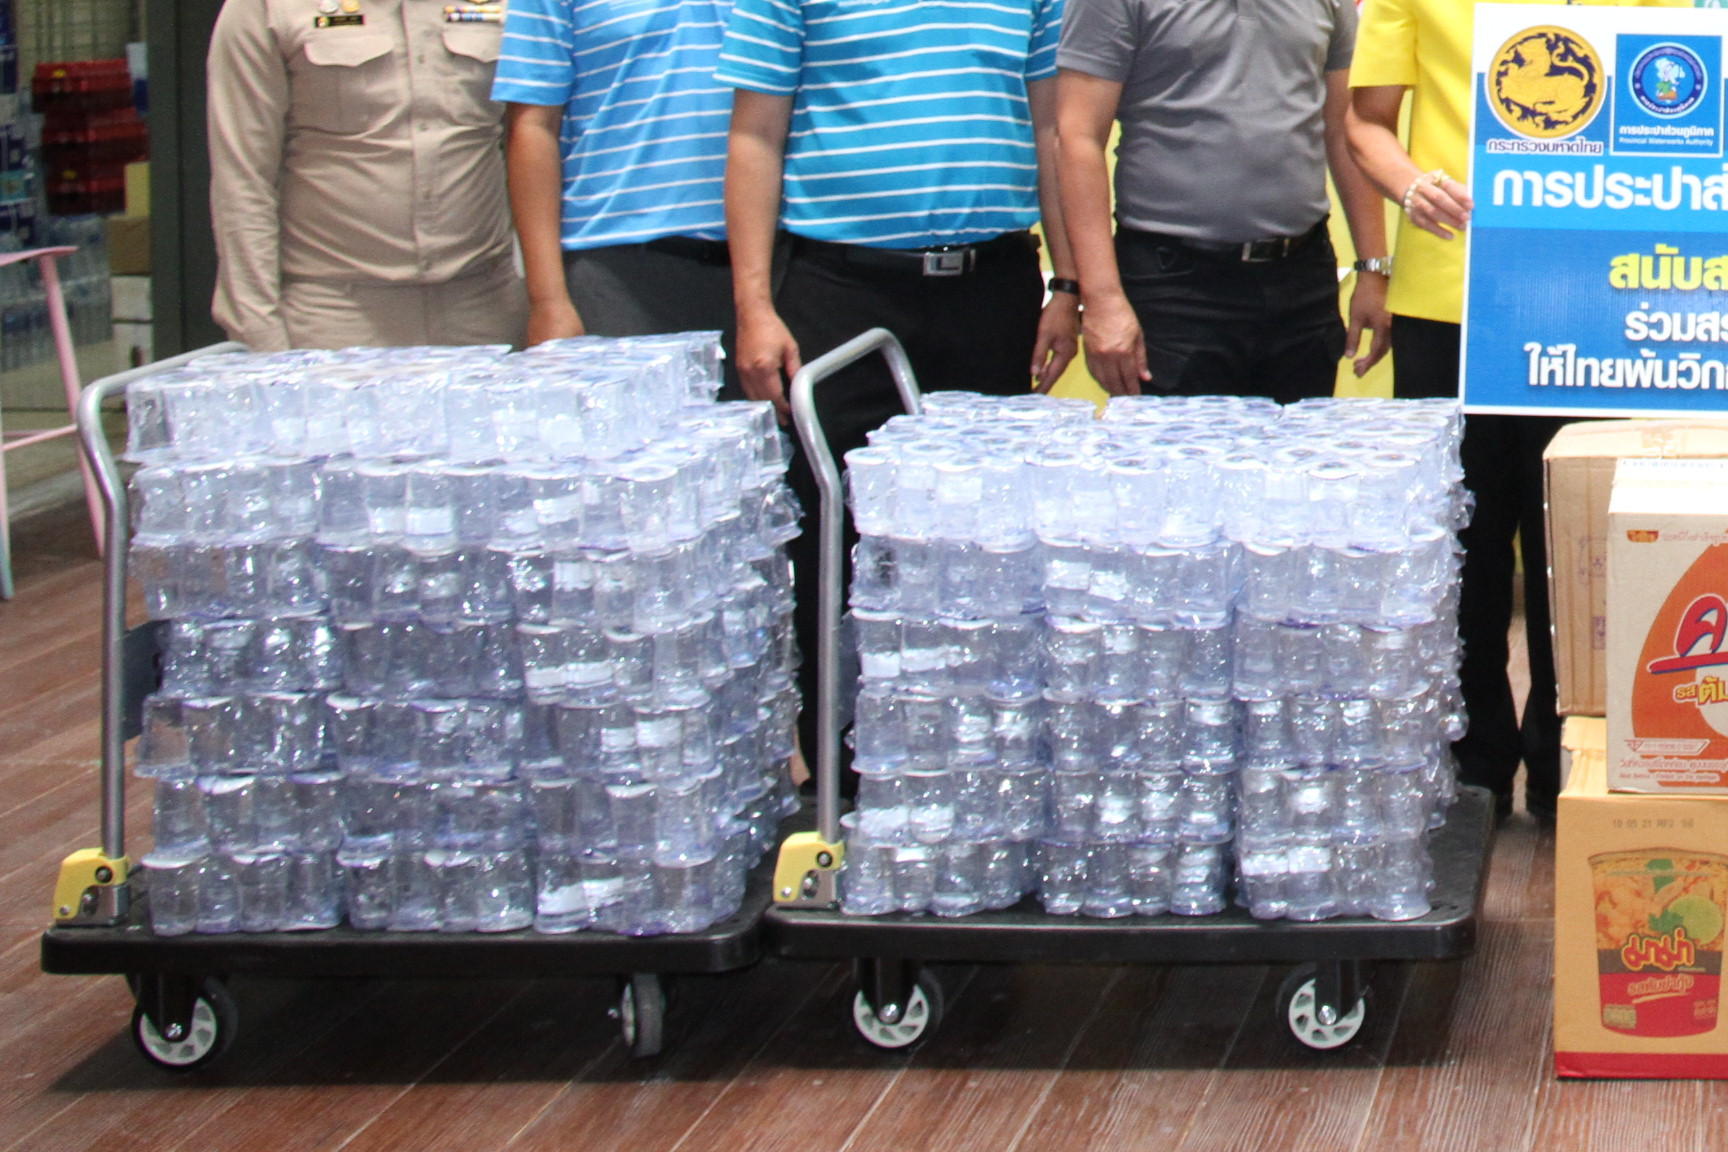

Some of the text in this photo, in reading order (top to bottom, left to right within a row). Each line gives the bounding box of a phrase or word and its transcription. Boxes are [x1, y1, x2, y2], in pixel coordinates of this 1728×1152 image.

[1618, 123, 1715, 140] การประปาส่วนภูมิภาค
[1488, 138, 1603, 155] กระทรวงมหาดไทย
[1622, 928, 1694, 970] มาม่า
